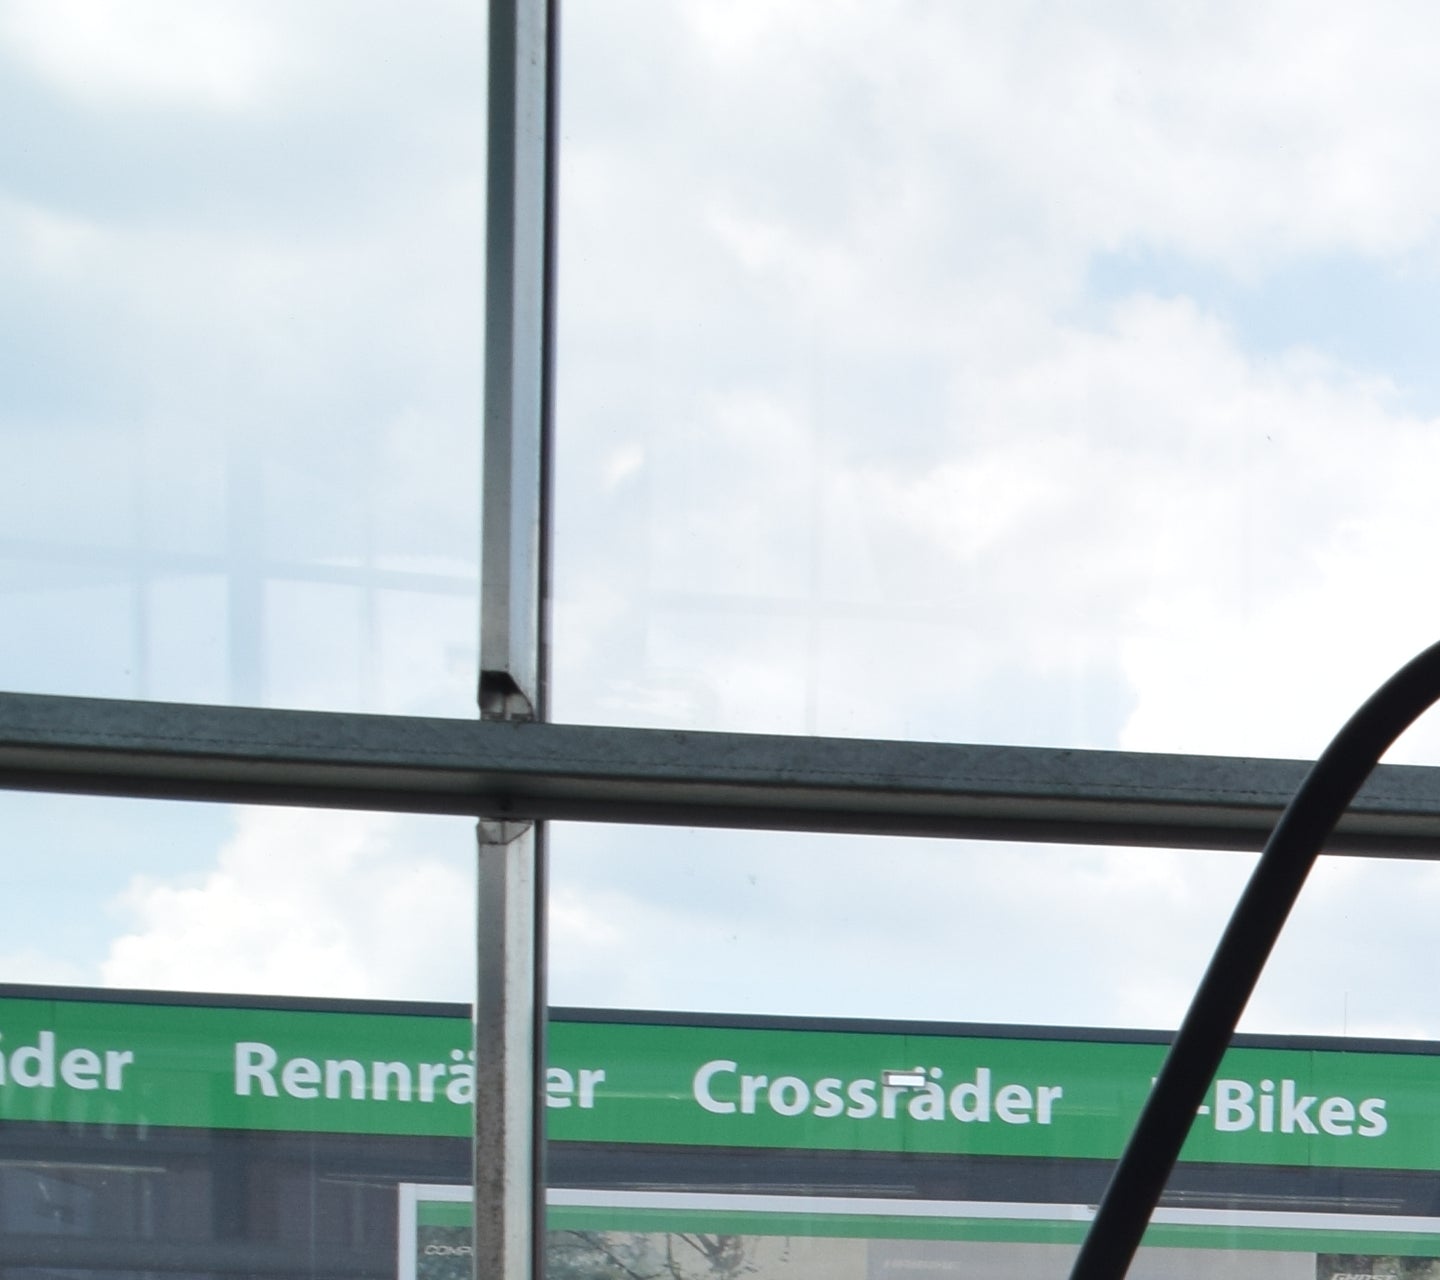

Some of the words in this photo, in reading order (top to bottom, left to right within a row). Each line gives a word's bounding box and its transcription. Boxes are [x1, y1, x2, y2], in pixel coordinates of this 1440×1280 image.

[0, 1031, 134, 1091] der
[234, 1041, 606, 1109] Rennräer
[692, 1059, 1064, 1126] Crossräder
[1152, 1077, 1388, 1138] -Bikes
